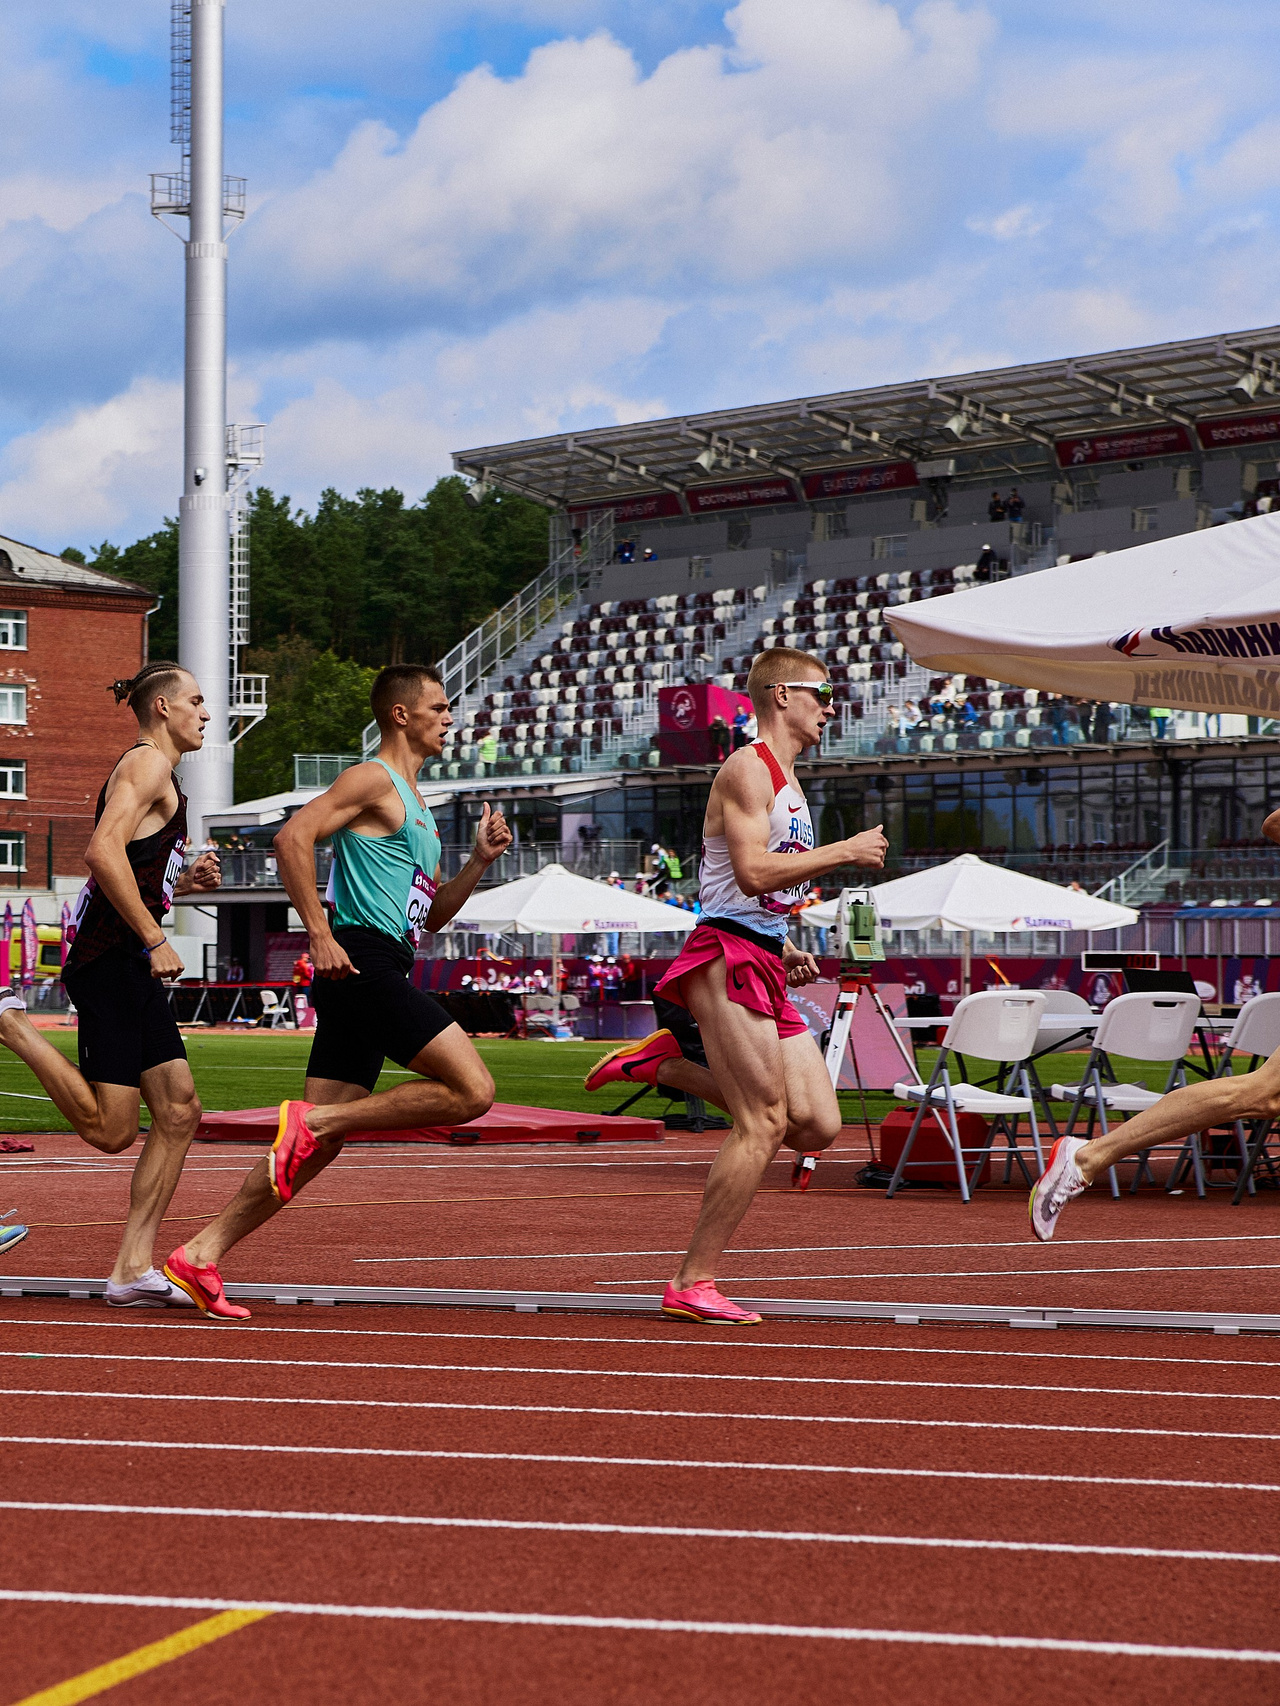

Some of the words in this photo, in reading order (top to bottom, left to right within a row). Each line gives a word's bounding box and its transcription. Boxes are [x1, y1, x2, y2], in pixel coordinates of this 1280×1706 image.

[823, 471, 897, 492] ЕКАТЕРИНБУРГ
[698, 490, 748, 506] ВОСТОЧНАЯ
[789, 817, 812, 845] RUSS
